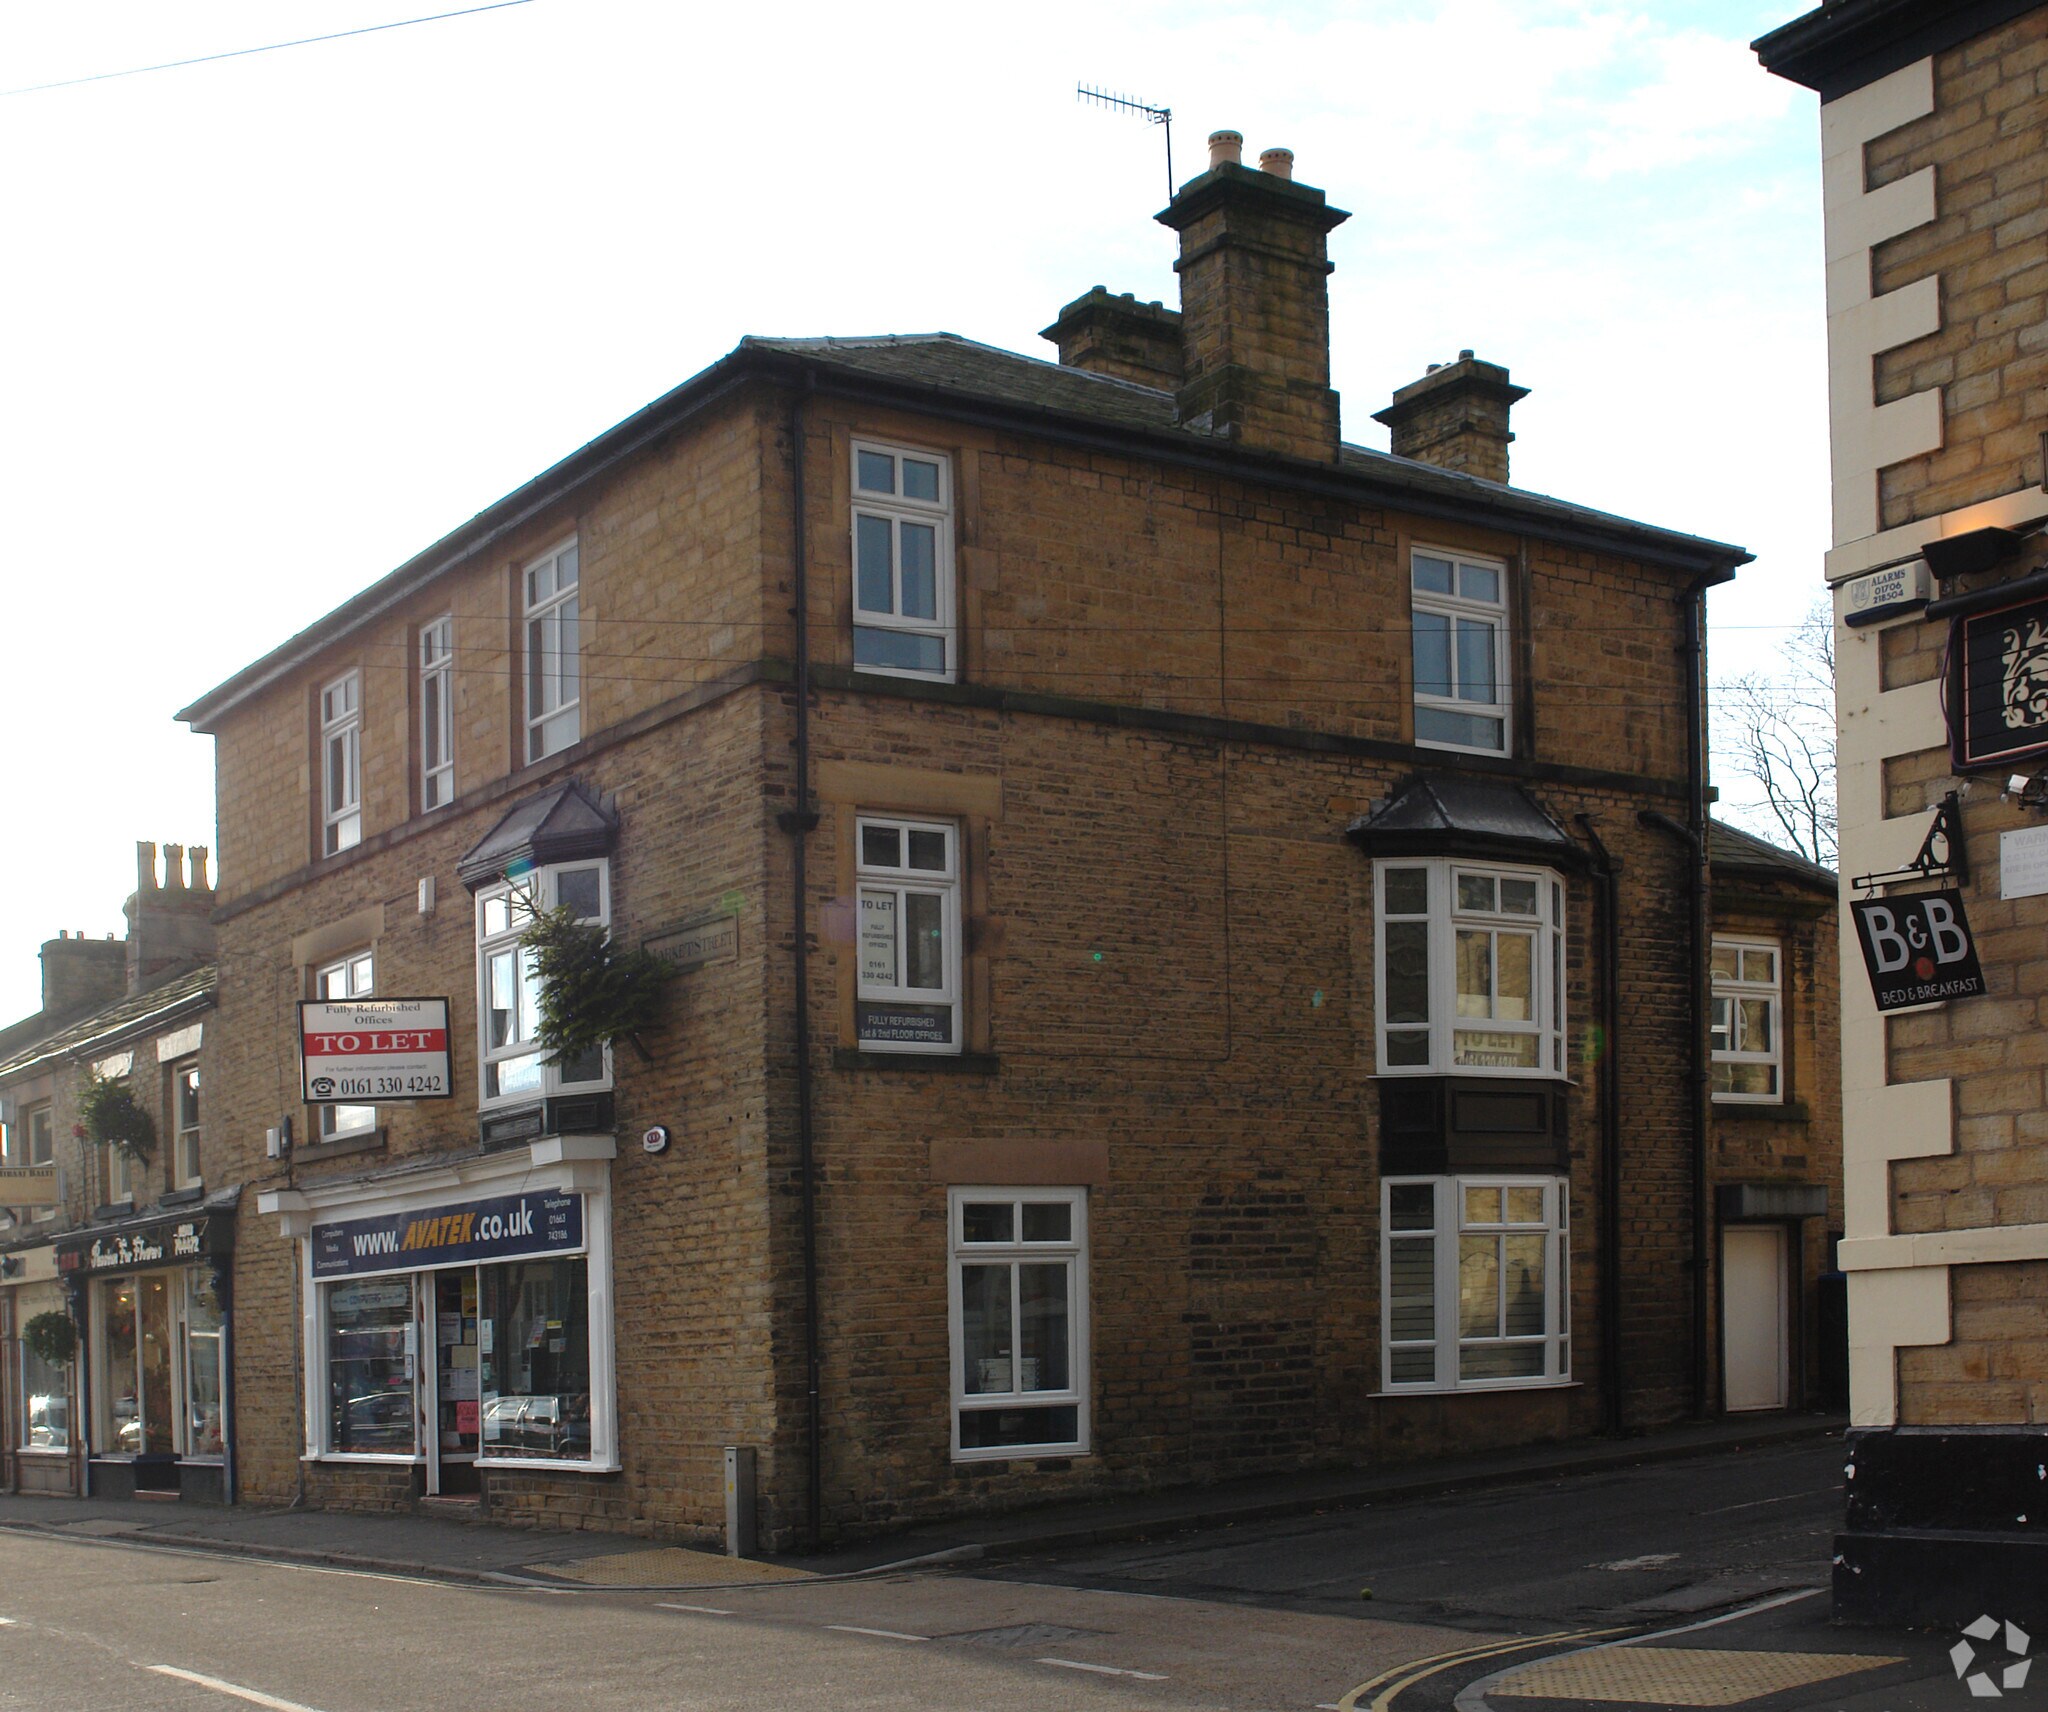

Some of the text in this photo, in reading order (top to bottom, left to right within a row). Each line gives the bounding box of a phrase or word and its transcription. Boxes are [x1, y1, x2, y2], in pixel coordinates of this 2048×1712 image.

[1871, 569, 1906, 586] ALARMS
[1875, 582, 1902, 596] 01706
[862, 900, 893, 911] TO LET
[1860, 898, 1968, 974] B&B
[862, 971, 875, 979] 330
[1882, 977, 1978, 1004] BED & BREAKFAST
[325, 1003, 421, 1016] Fully Refurbished
[354, 1015, 393, 1025] Offices
[868, 1015, 935, 1028] FULLY REFURBISHED
[891, 1029, 914, 1040] FLOOR
[315, 1031, 432, 1053] TO LET
[355, 1064, 386, 1072] information
[387, 1064, 405, 1072] please
[340, 1075, 442, 1095] 0161 330 4242
[543, 1198, 572, 1211] Telephone
[548, 1213, 566, 1225] 01663
